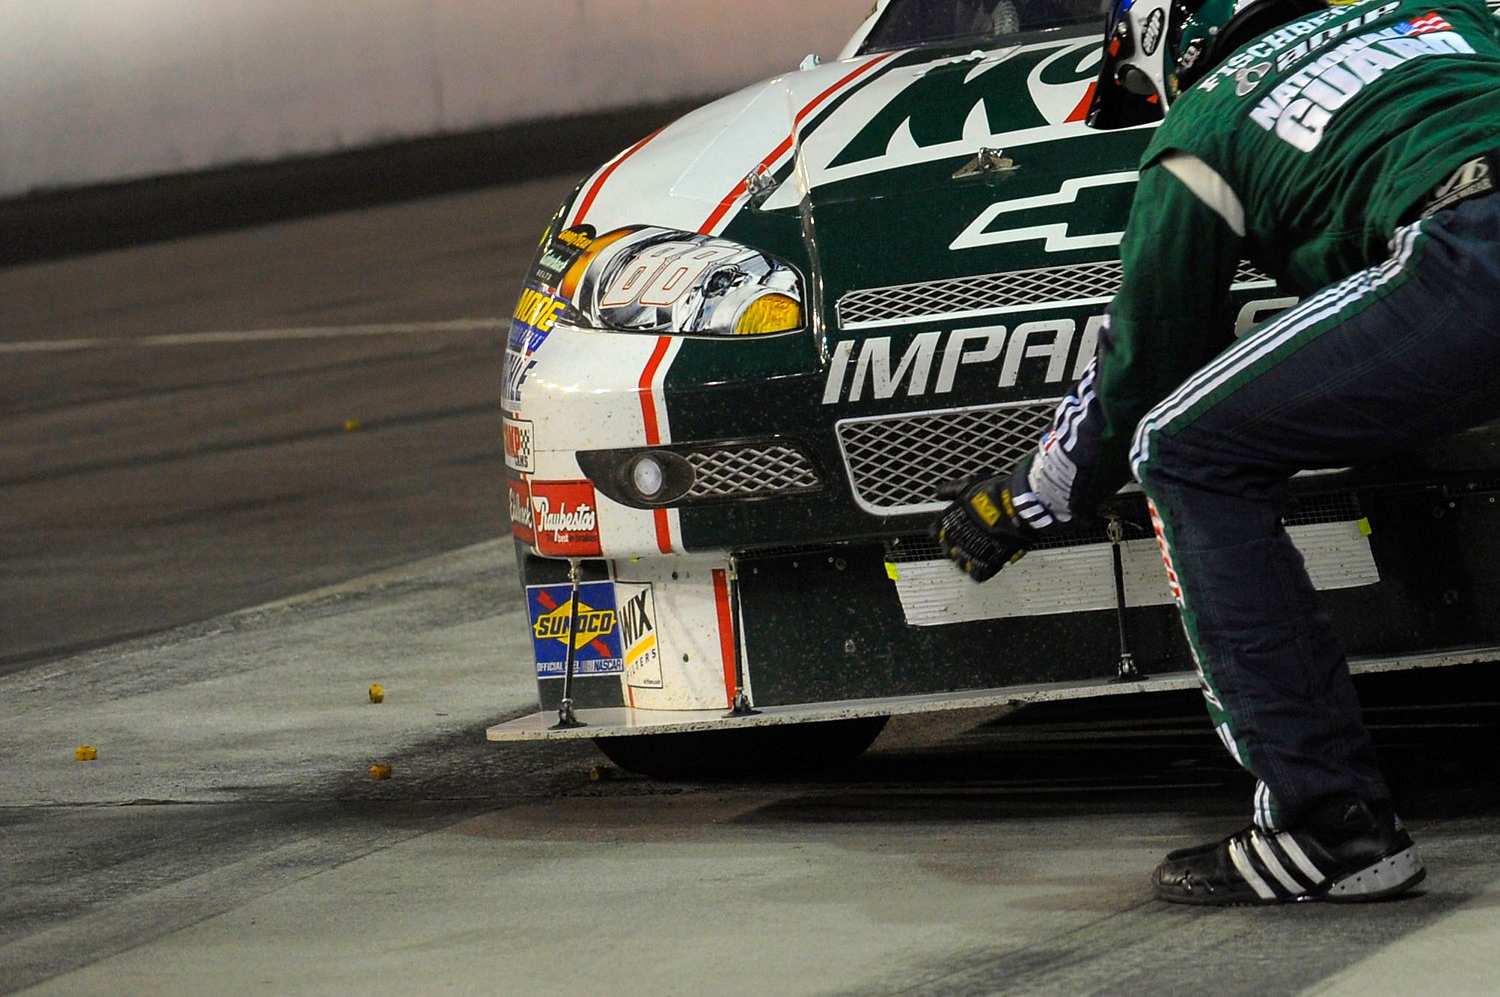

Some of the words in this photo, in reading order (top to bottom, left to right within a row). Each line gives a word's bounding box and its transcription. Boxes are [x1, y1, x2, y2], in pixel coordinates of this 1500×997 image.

[1276, 31, 1477, 153] GUARD
[600, 241, 748, 308] 88
[532, 496, 596, 542] Raybestos
[619, 587, 653, 650] WIX
[595, 658, 621, 672] NASCAR
